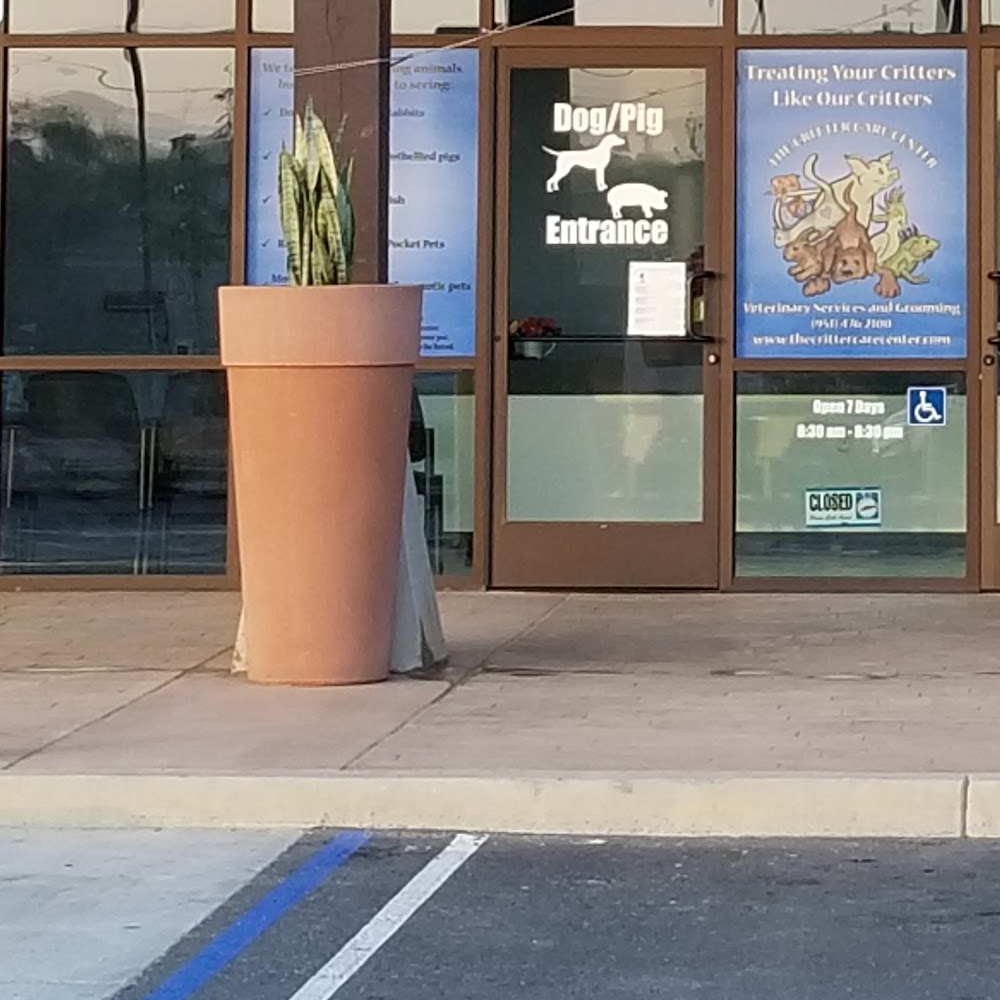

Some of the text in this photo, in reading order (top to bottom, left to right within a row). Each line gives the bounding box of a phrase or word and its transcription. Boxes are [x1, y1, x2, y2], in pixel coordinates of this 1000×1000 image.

[745, 64, 957, 84] Treating Your Critters
[773, 89, 933, 107] Like Our Critters
[390, 107, 425, 118] abbits
[553, 102, 664, 136] Dog/Pig
[390, 151, 461, 164] otbellied pigs
[545, 215, 669, 245] Entrance
[423, 239, 446, 250] Pets
[743, 302, 961, 316] Veterinary Services and Grooming
[813, 399, 885, 416] Open 7 Days
[826, 426, 846, 439] am
[883, 426, 904, 440] pm
[809, 493, 854, 512] CLOSED
